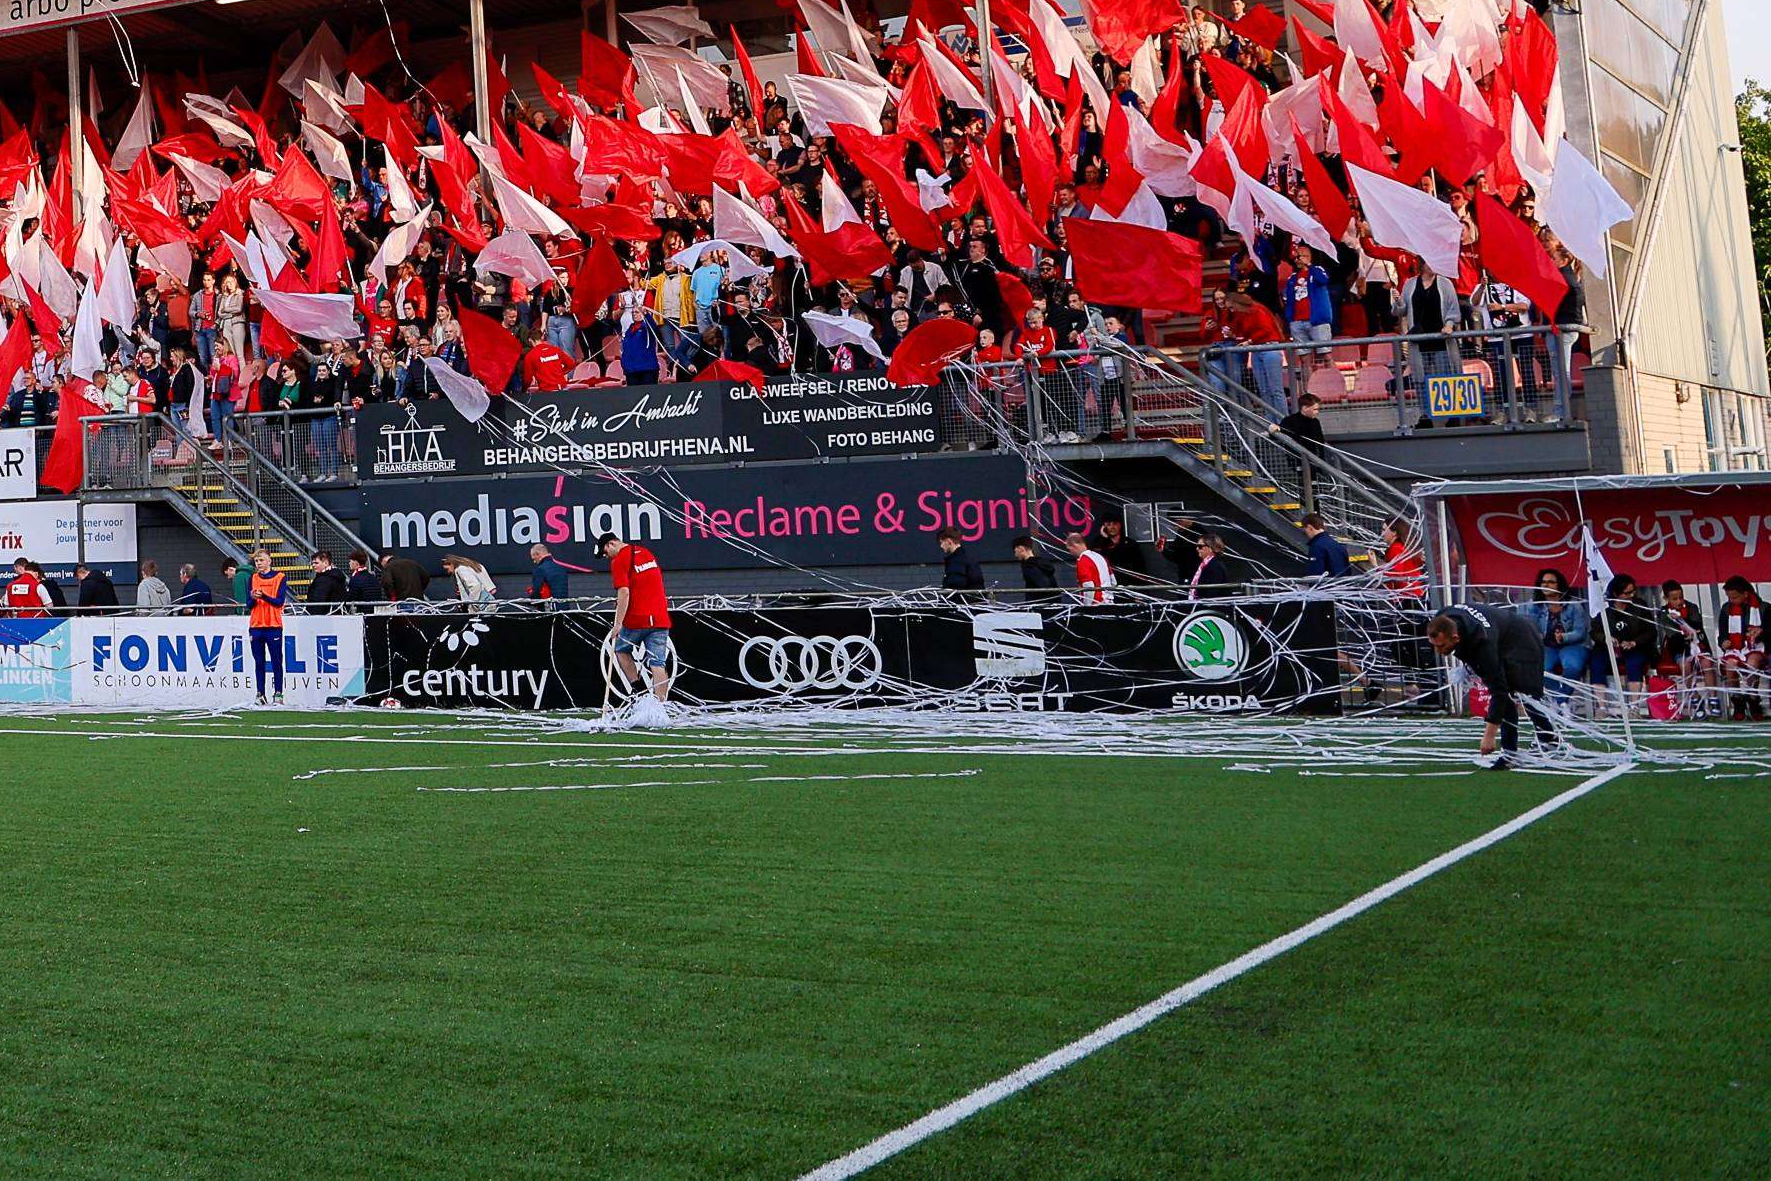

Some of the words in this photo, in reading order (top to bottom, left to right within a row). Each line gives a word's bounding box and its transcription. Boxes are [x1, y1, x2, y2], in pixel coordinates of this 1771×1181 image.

[730, 378, 839, 401] GLASWEEFSEL
[1431, 377, 1478, 411] 29/30
[582, 414, 599, 431] in
[603, 389, 704, 433] Ambacht
[763, 409, 802, 426] LUXE
[803, 402, 934, 424] WANDBEKLEDING
[827, 432, 868, 449] FOTO
[871, 428, 936, 447] BEHANG
[484, 435, 755, 467] BEHANGERSBEDRIJFHENA.NL
[374, 460, 456, 475] BEHANGERSBEDRIJF
[56, 518, 69, 529] De
[102, 517, 124, 528] voor
[381, 477, 662, 549] mediasign
[684, 495, 862, 540] Reclame
[874, 492, 906, 534] &
[918, 486, 1094, 543] Signing
[55, 532, 78, 545] jouw
[94, 531, 115, 542] doel
[402, 663, 549, 711] century
[1172, 691, 1263, 712] ŠKODA
